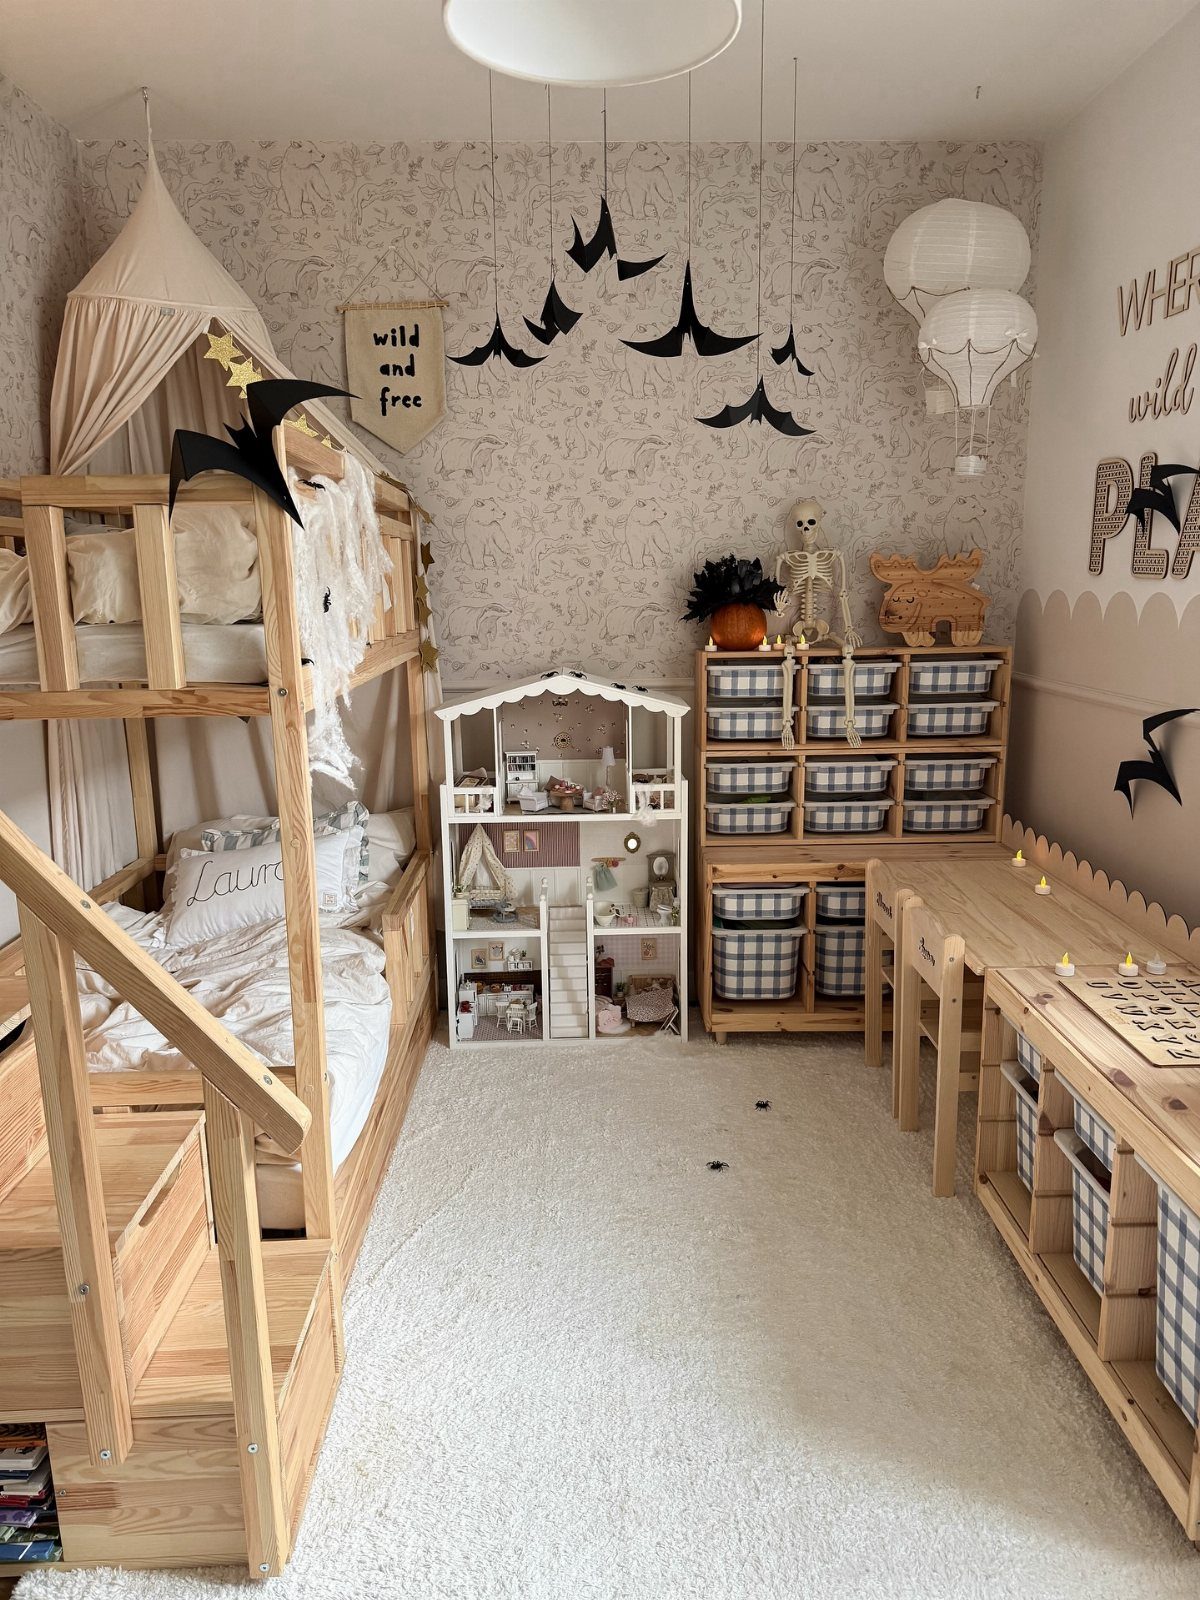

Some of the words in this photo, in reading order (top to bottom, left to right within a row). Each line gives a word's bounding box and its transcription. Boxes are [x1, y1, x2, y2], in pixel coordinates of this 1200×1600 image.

[1117, 245, 1200, 337] WHER
[373, 324, 420, 348] wild
[379, 353, 416, 377] and
[1128, 342, 1198, 423] wild
[379, 387, 422, 416] free
